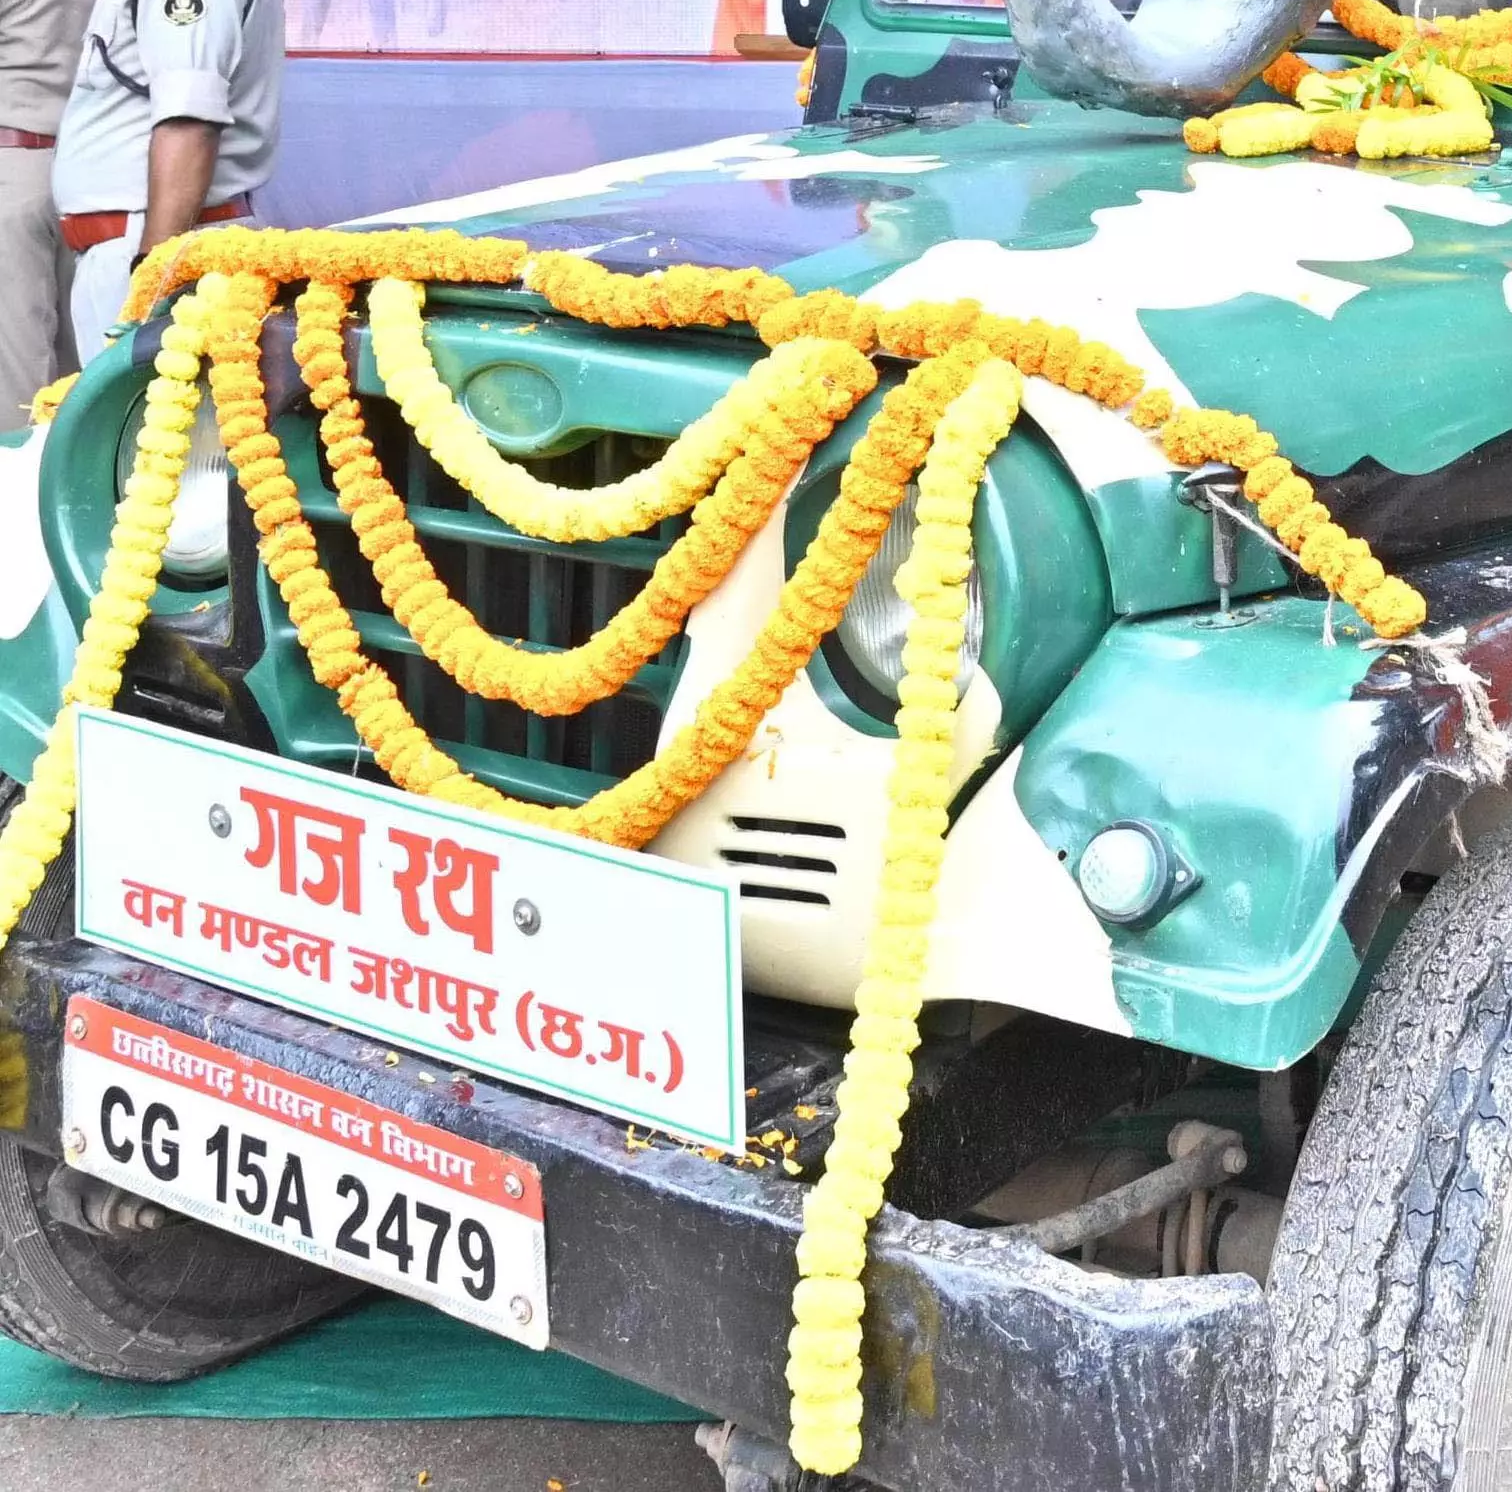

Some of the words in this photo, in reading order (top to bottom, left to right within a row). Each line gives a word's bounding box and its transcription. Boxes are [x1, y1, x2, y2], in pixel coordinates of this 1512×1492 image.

[240, 786, 365, 914] गज
[389, 826, 499, 955] रथ
[121, 878, 184, 938] वन
[200, 901, 334, 982] मण्डल
[349, 945, 499, 1042] जशपुर
[514, 990, 685, 1094] (छ.ग.)
[100, 1084, 181, 1182] CG
[205, 1123, 314, 1239] 15A
[335, 1173, 497, 1301] 2479
[243, 1073, 324, 1129] शासन
[331, 1106, 375, 1147] वन
[381, 1122, 475, 1186] विभाग
